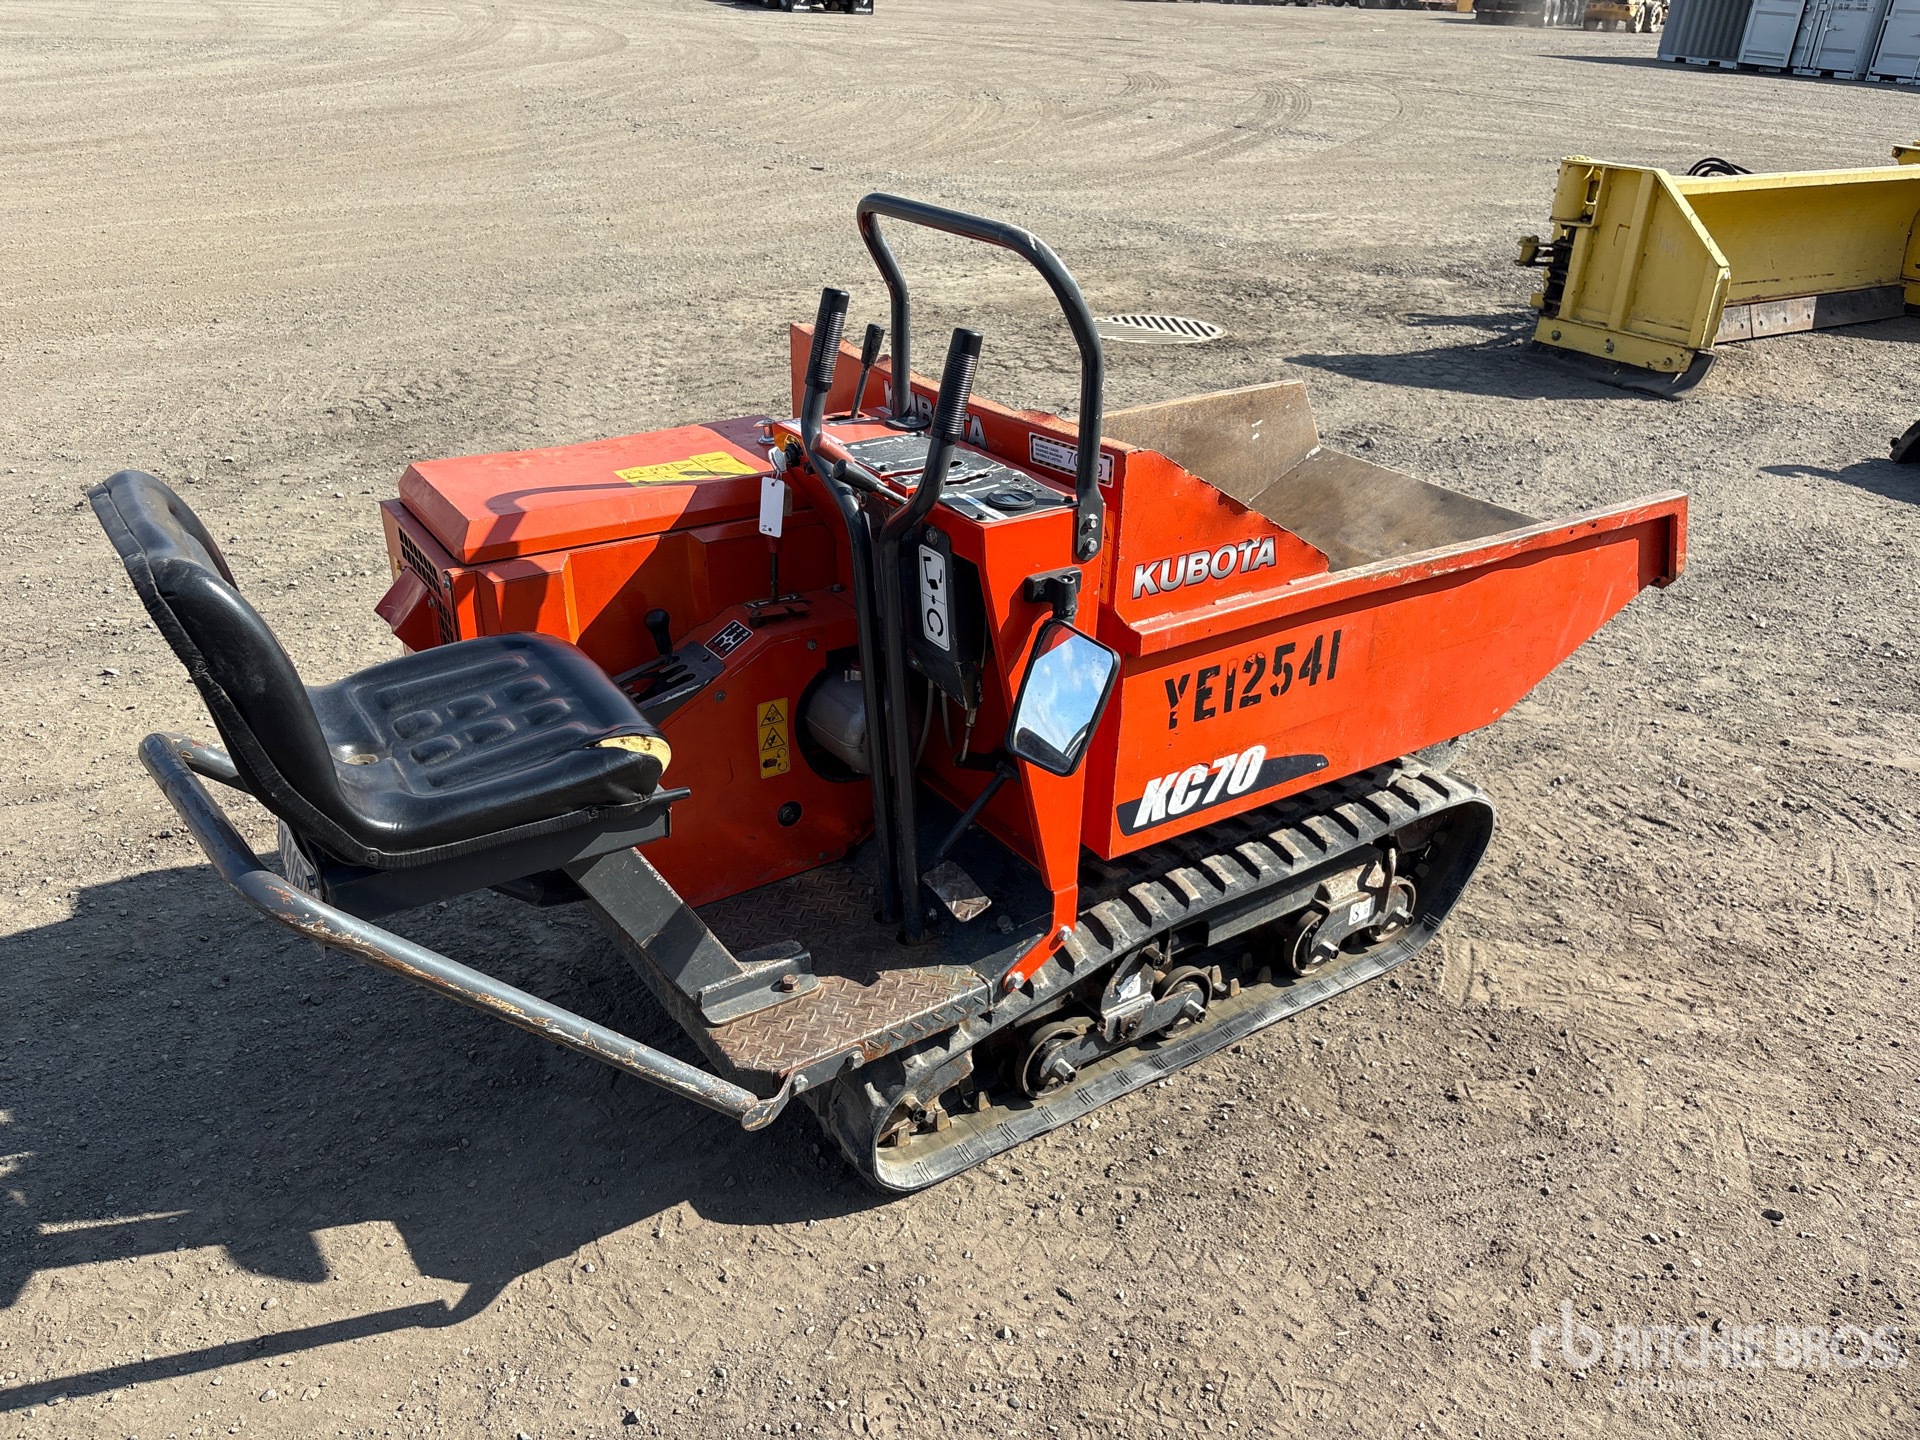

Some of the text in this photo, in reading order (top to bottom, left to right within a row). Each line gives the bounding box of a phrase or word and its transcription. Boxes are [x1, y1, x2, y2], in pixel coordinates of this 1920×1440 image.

[1132, 536, 1276, 599] KUBOTA
[1164, 629, 1342, 731] YE12541
[1132, 744, 1267, 829] KC70
